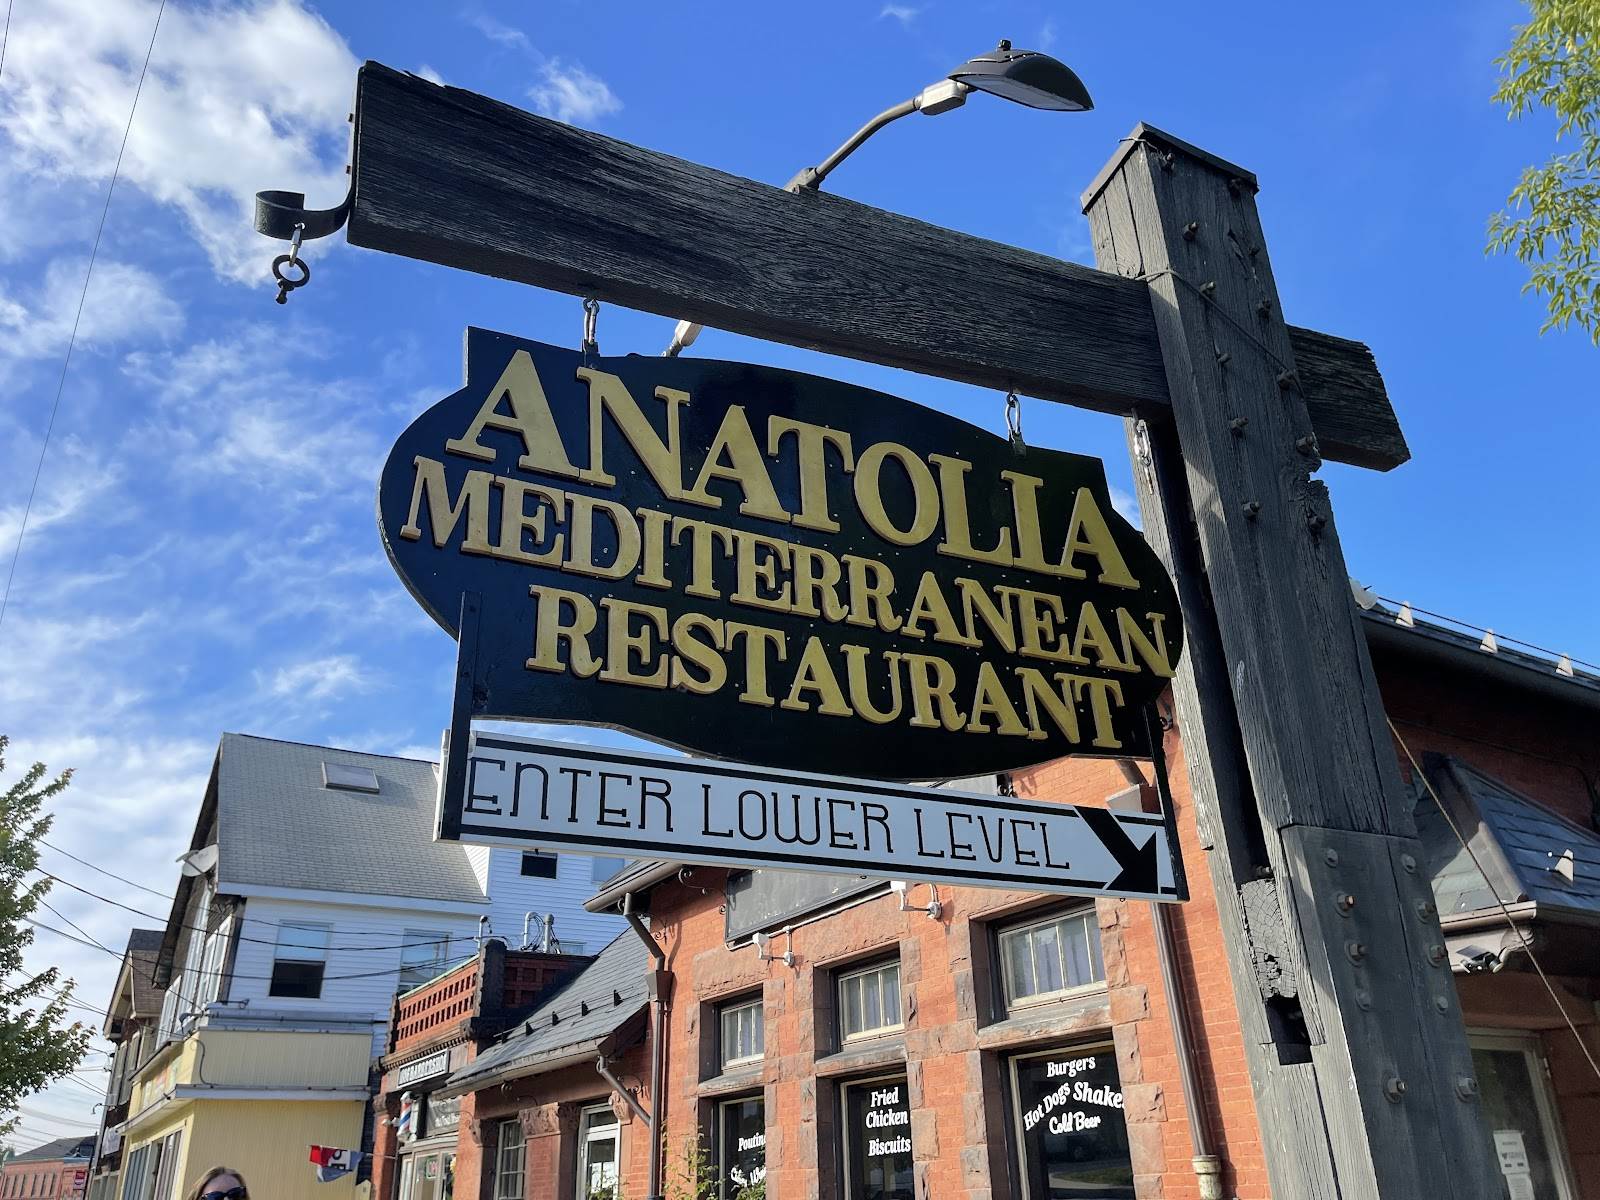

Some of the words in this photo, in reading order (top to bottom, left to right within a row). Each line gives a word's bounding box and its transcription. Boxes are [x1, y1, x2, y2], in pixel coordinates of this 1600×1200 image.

[446, 350, 1139, 589] ANATOLIA
[400, 456, 1176, 678] MEDITERRANEAN
[526, 585, 1124, 748] RESTAURANT
[464, 757, 674, 832] ENTER
[701, 783, 894, 853] LOWER
[914, 808, 1070, 869] LEVEL
[1047, 1057, 1096, 1077] Burgers
[870, 1086, 900, 1107] Fried
[1023, 1104, 1044, 1130] Hot
[1043, 1082, 1071, 1113] Dogs
[1073, 1082, 1124, 1109] Shake
[865, 1108, 909, 1128] Chicken
[1049, 1112, 1073, 1134] Cold
[1073, 1111, 1101, 1131] Beer
[738, 1132, 766, 1152] Poutin
[867, 1135, 912, 1156] Biscuits
